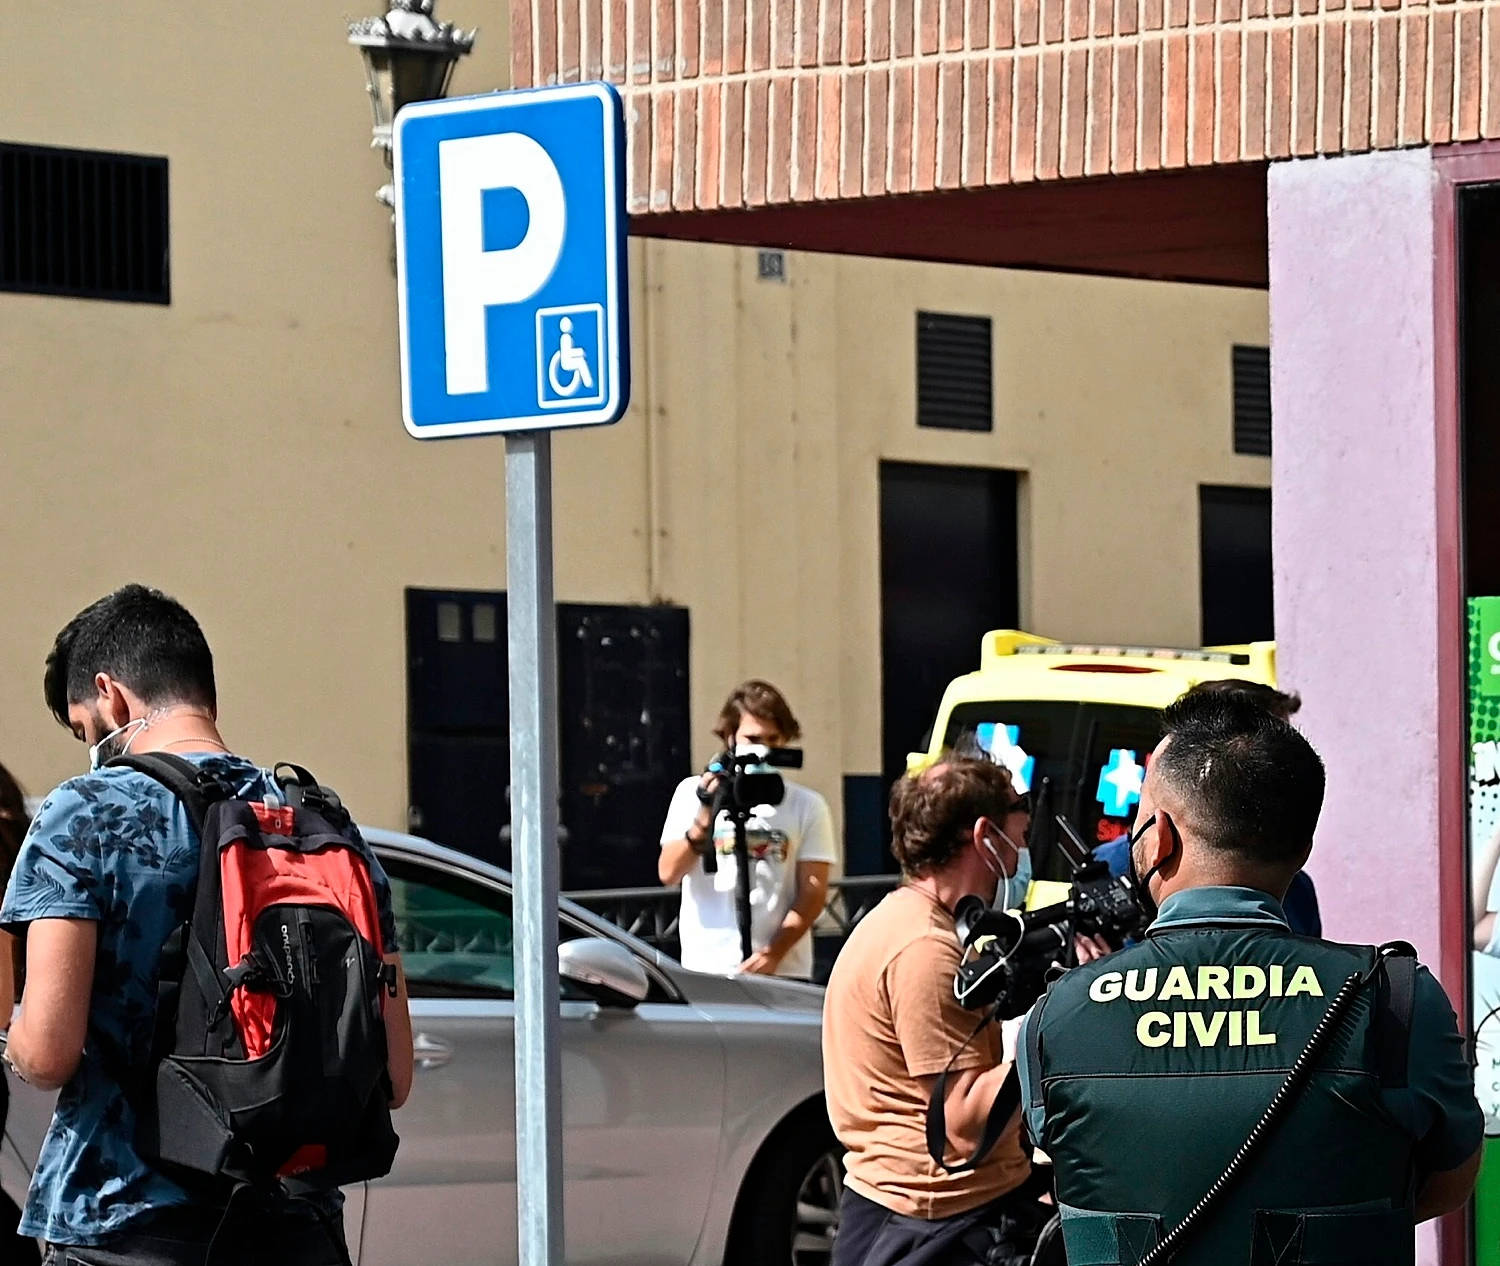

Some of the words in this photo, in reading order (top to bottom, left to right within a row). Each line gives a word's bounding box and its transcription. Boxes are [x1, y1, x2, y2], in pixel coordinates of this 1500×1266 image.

[439, 132, 567, 395] P
[280, 925, 297, 985] Quechua
[1088, 965, 1325, 1003] GUARDIA
[1135, 1010, 1278, 1049] CIVIL
[1491, 1102, 1500, 1117] y
